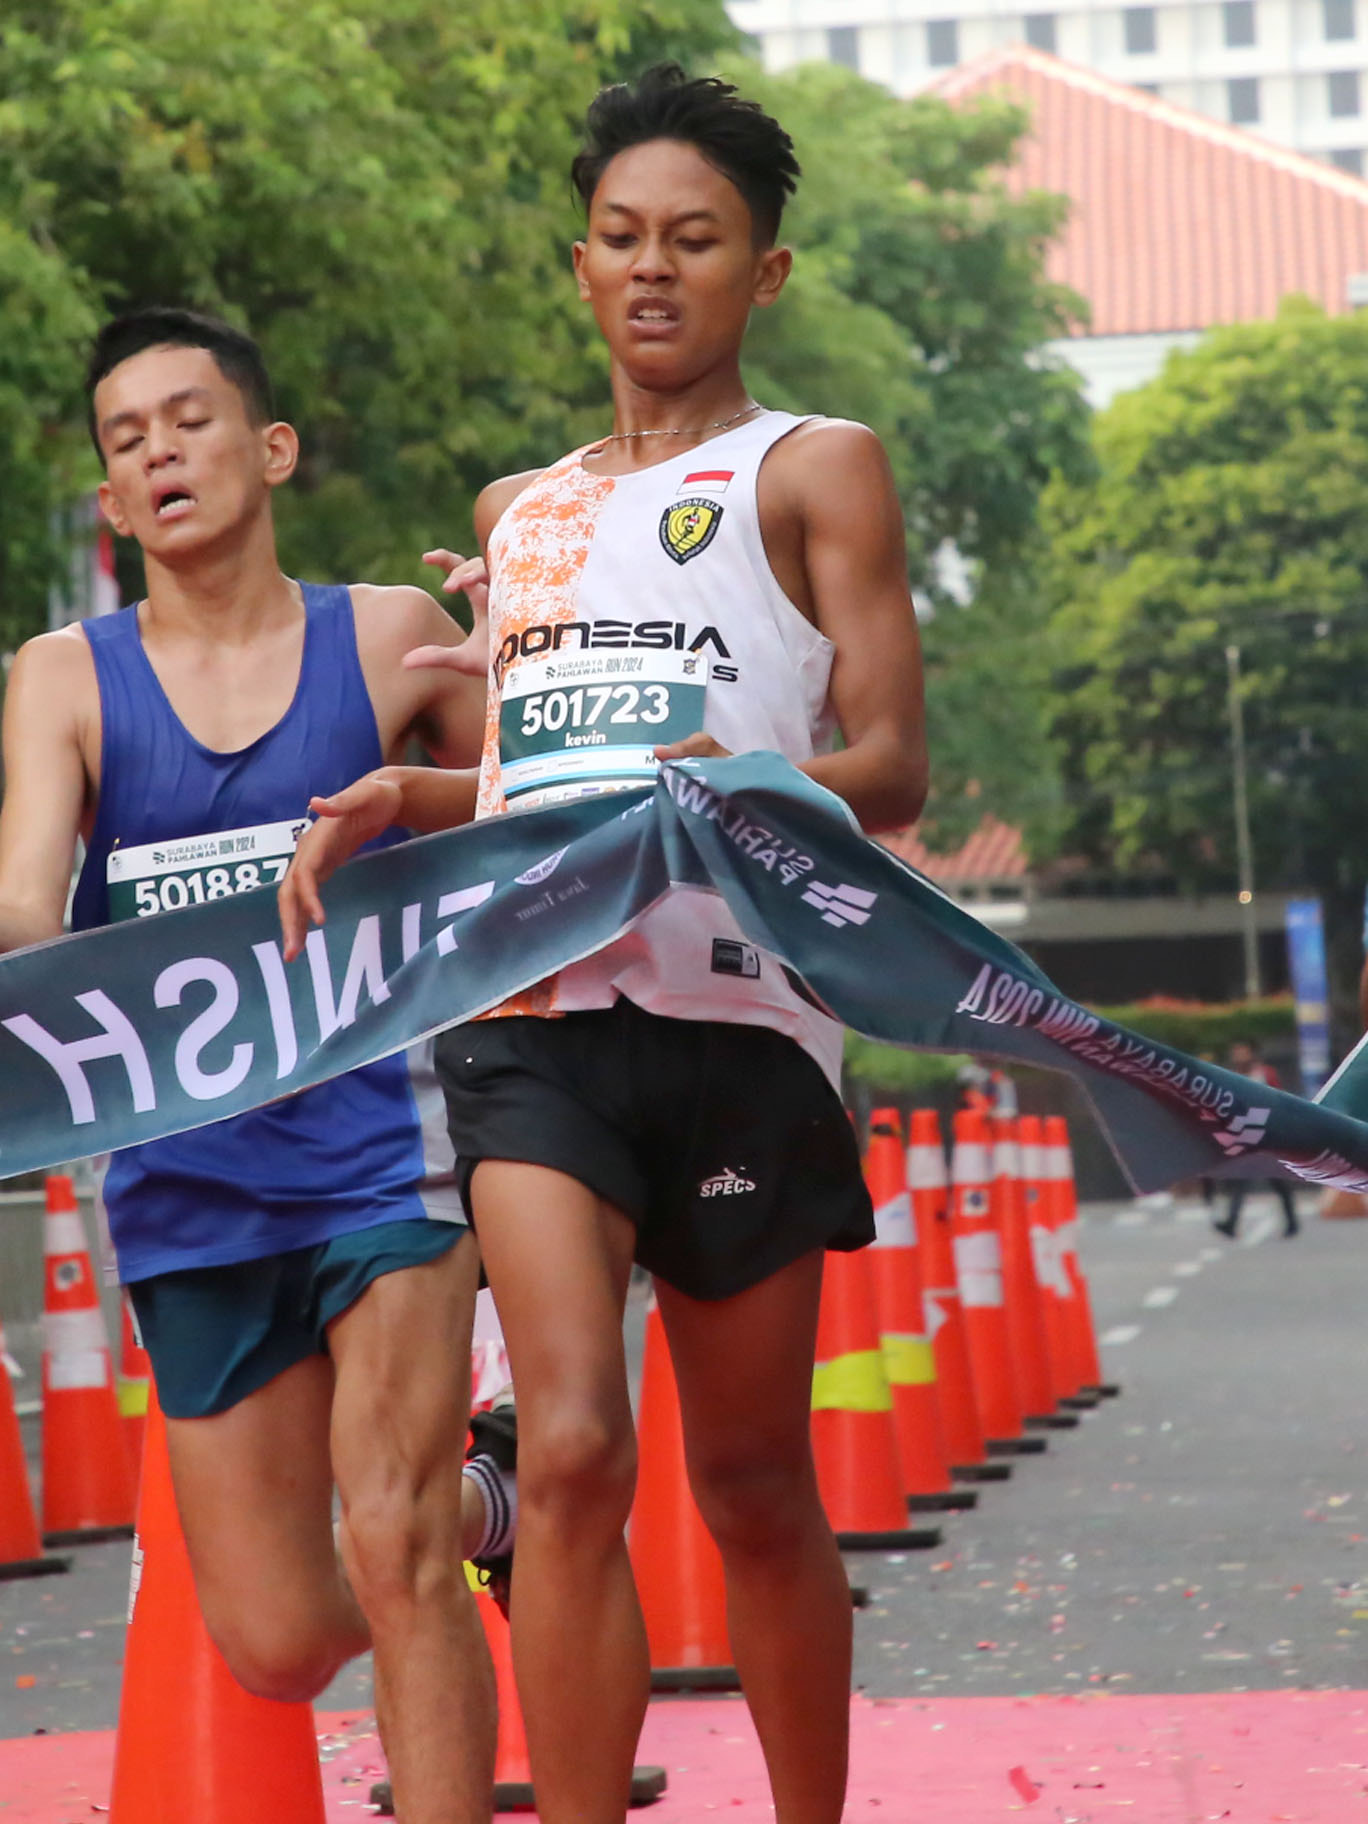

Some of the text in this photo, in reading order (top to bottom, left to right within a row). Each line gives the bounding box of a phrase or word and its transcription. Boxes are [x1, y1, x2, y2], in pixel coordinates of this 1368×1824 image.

[669, 499, 720, 512] INDONESIA
[558, 659, 603, 670] SURABAYA
[605, 658, 622, 672] RUN
[557, 667, 603, 678] PAHLAWAN
[521, 685, 670, 736] 501723
[565, 730, 607, 747] kevin
[167, 842, 216, 856] SURABAYA
[168, 850, 217, 864] PAHLAWAN
[135, 858, 289, 917] 501887
[700, 1180, 756, 1198] SPECS
